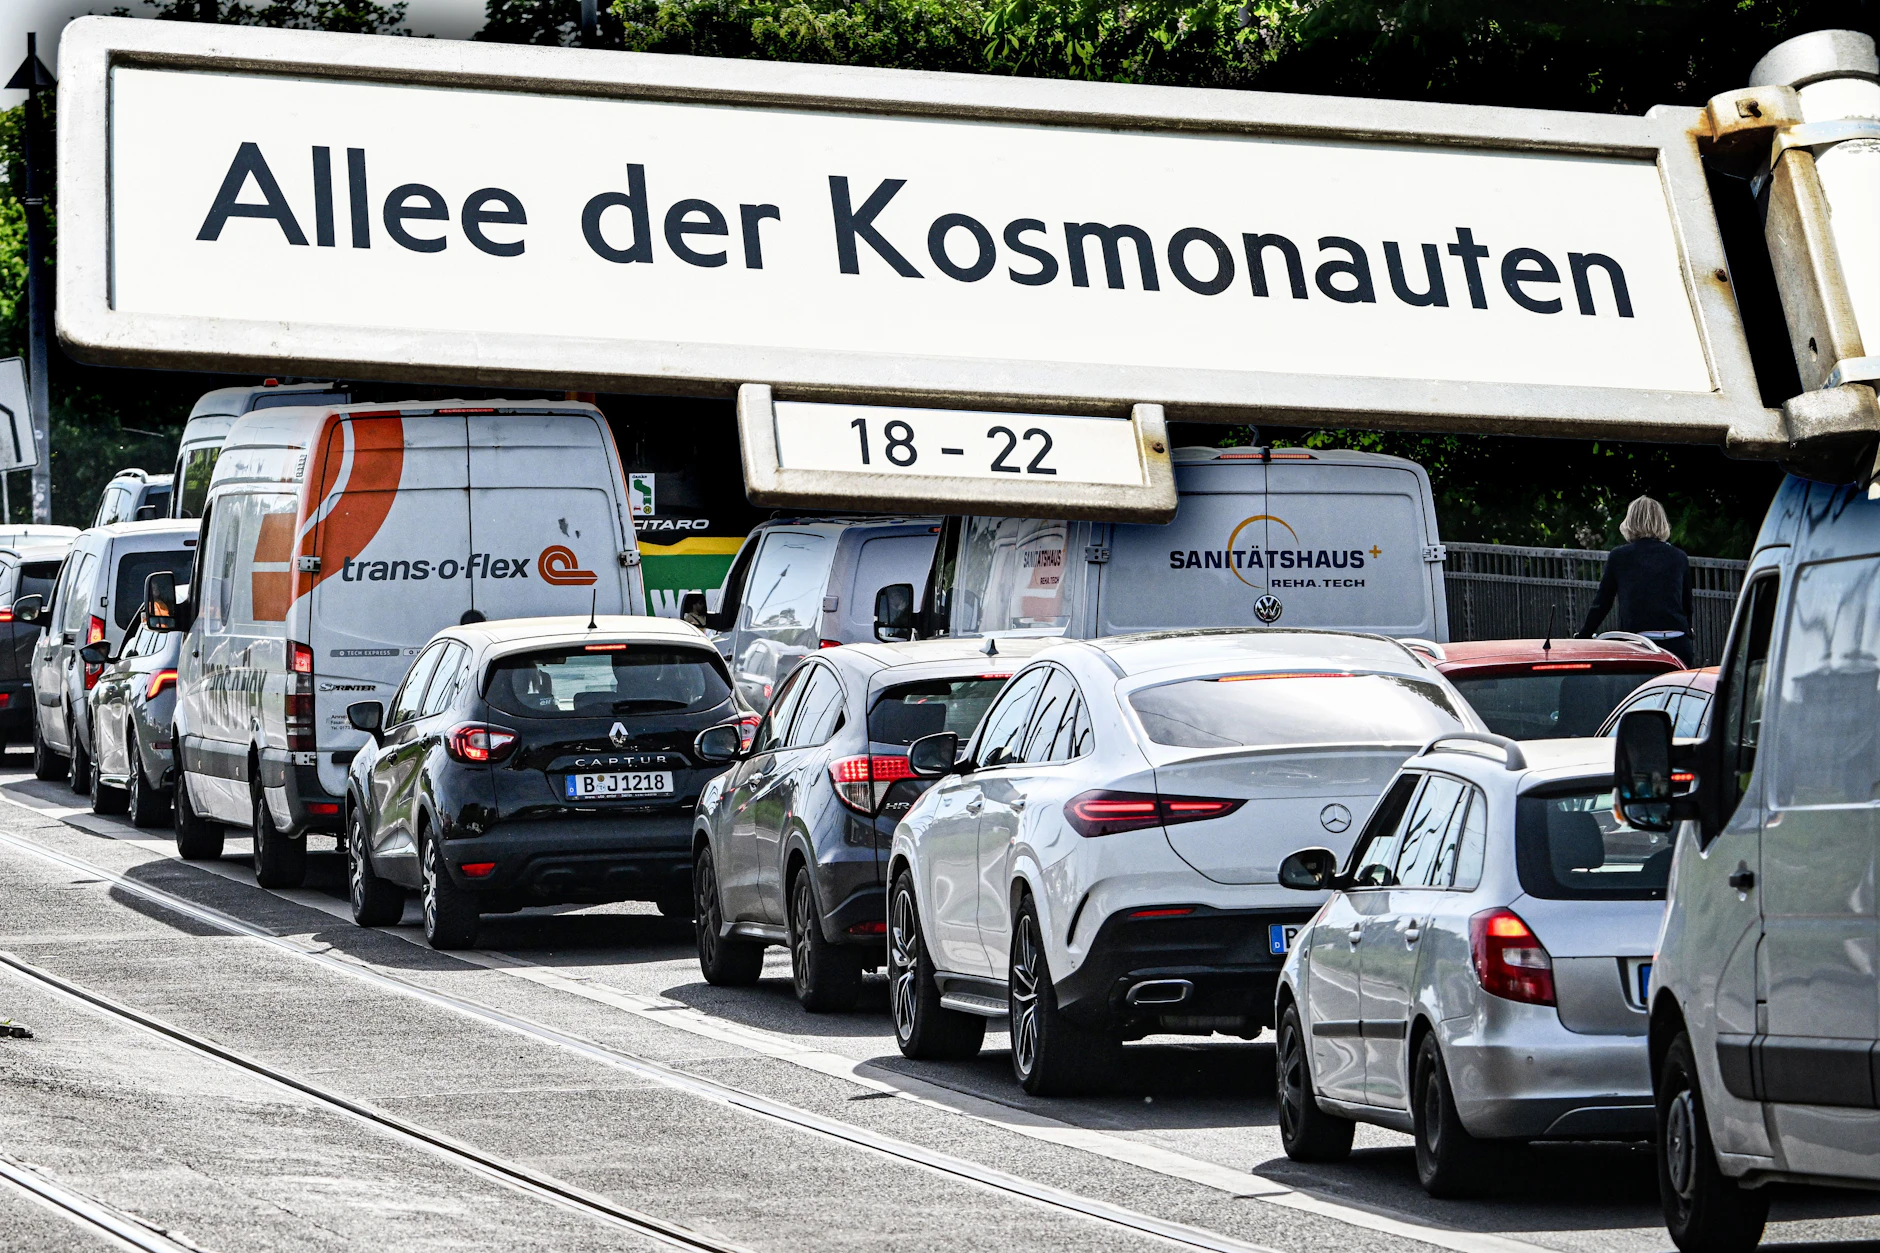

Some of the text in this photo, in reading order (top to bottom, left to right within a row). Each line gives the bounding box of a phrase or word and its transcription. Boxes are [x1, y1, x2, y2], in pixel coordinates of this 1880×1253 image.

[196, 142, 1634, 317] Allee der Kosmonauten
[850, 417, 918, 467] 18
[985, 424, 1058, 475] 22
[1169, 545, 1365, 569] SANITÄTSHAUS
[1271, 579, 1365, 588] REHA.TECH
[319, 682, 376, 692] SPRINTER
[574, 755, 667, 767] CAPTUR
[583, 776, 595, 793] B
